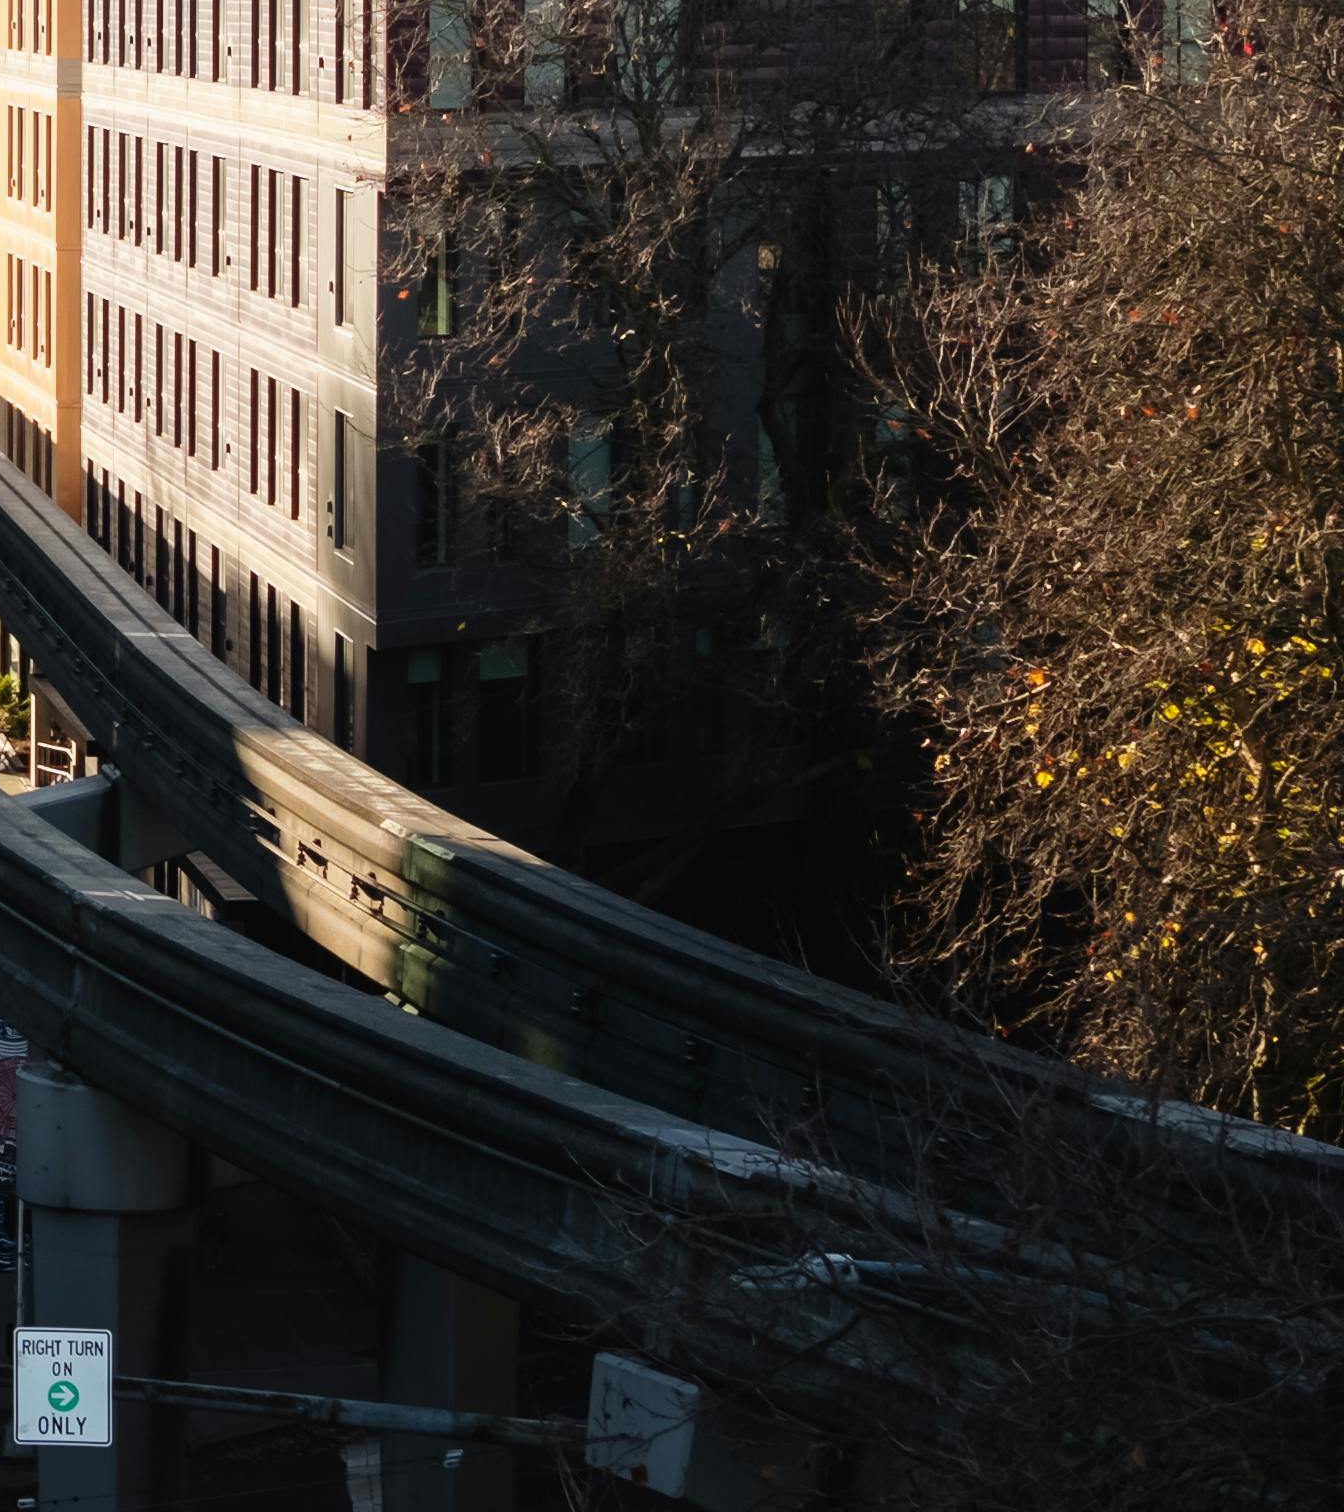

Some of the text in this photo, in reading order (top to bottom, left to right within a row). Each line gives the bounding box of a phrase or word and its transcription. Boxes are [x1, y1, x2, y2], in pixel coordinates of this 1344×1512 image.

[22, 1339, 104, 1357] RIGHT TURN
[52, 1361, 73, 1377] ON
[38, 1415, 87, 1436] ONLY
